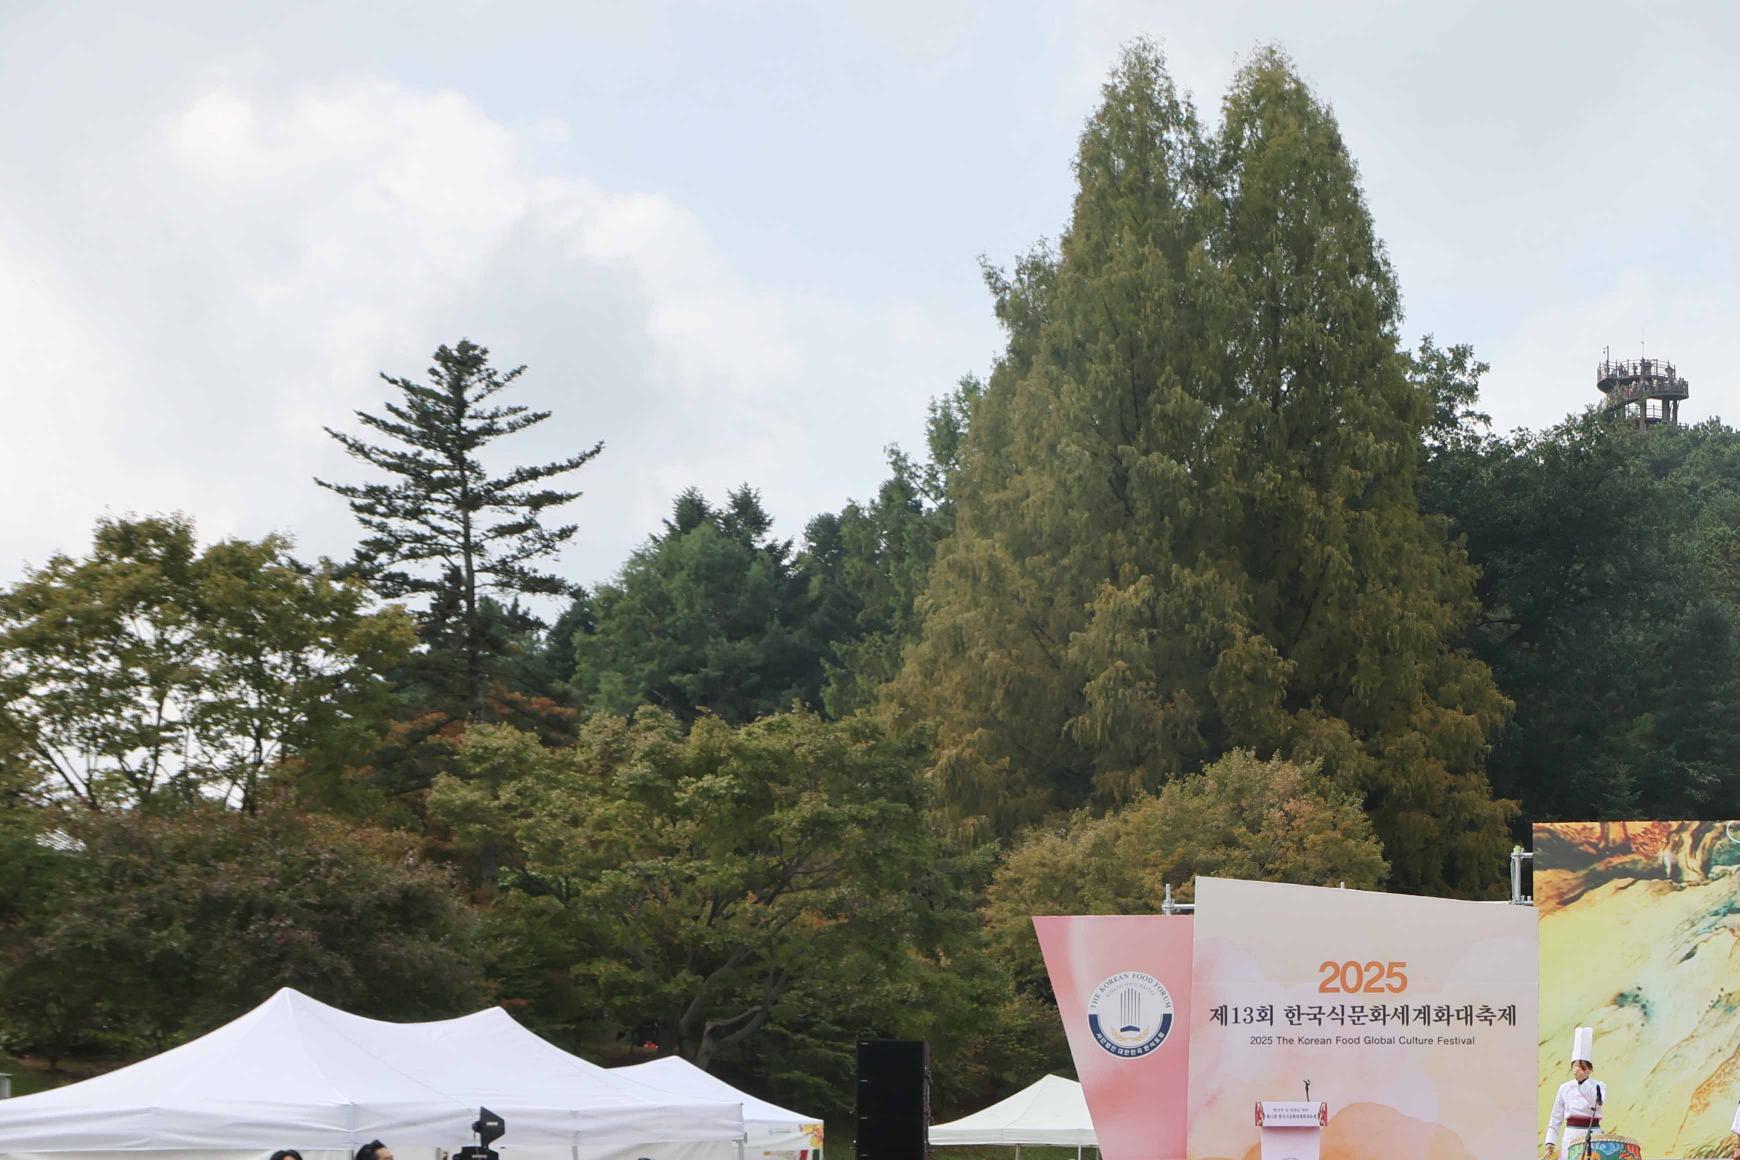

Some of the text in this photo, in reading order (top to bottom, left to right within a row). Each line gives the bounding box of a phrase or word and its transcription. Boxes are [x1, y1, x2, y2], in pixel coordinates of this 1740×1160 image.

[1132, 972, 1155, 984] FOOD
[1318, 960, 1409, 994] 2025
[1209, 1003, 1518, 1027] 제13회 한국식문화세계화대축제
[1250, 1035, 1476, 1046] 2025 The Korean Food Global Culture Festival
